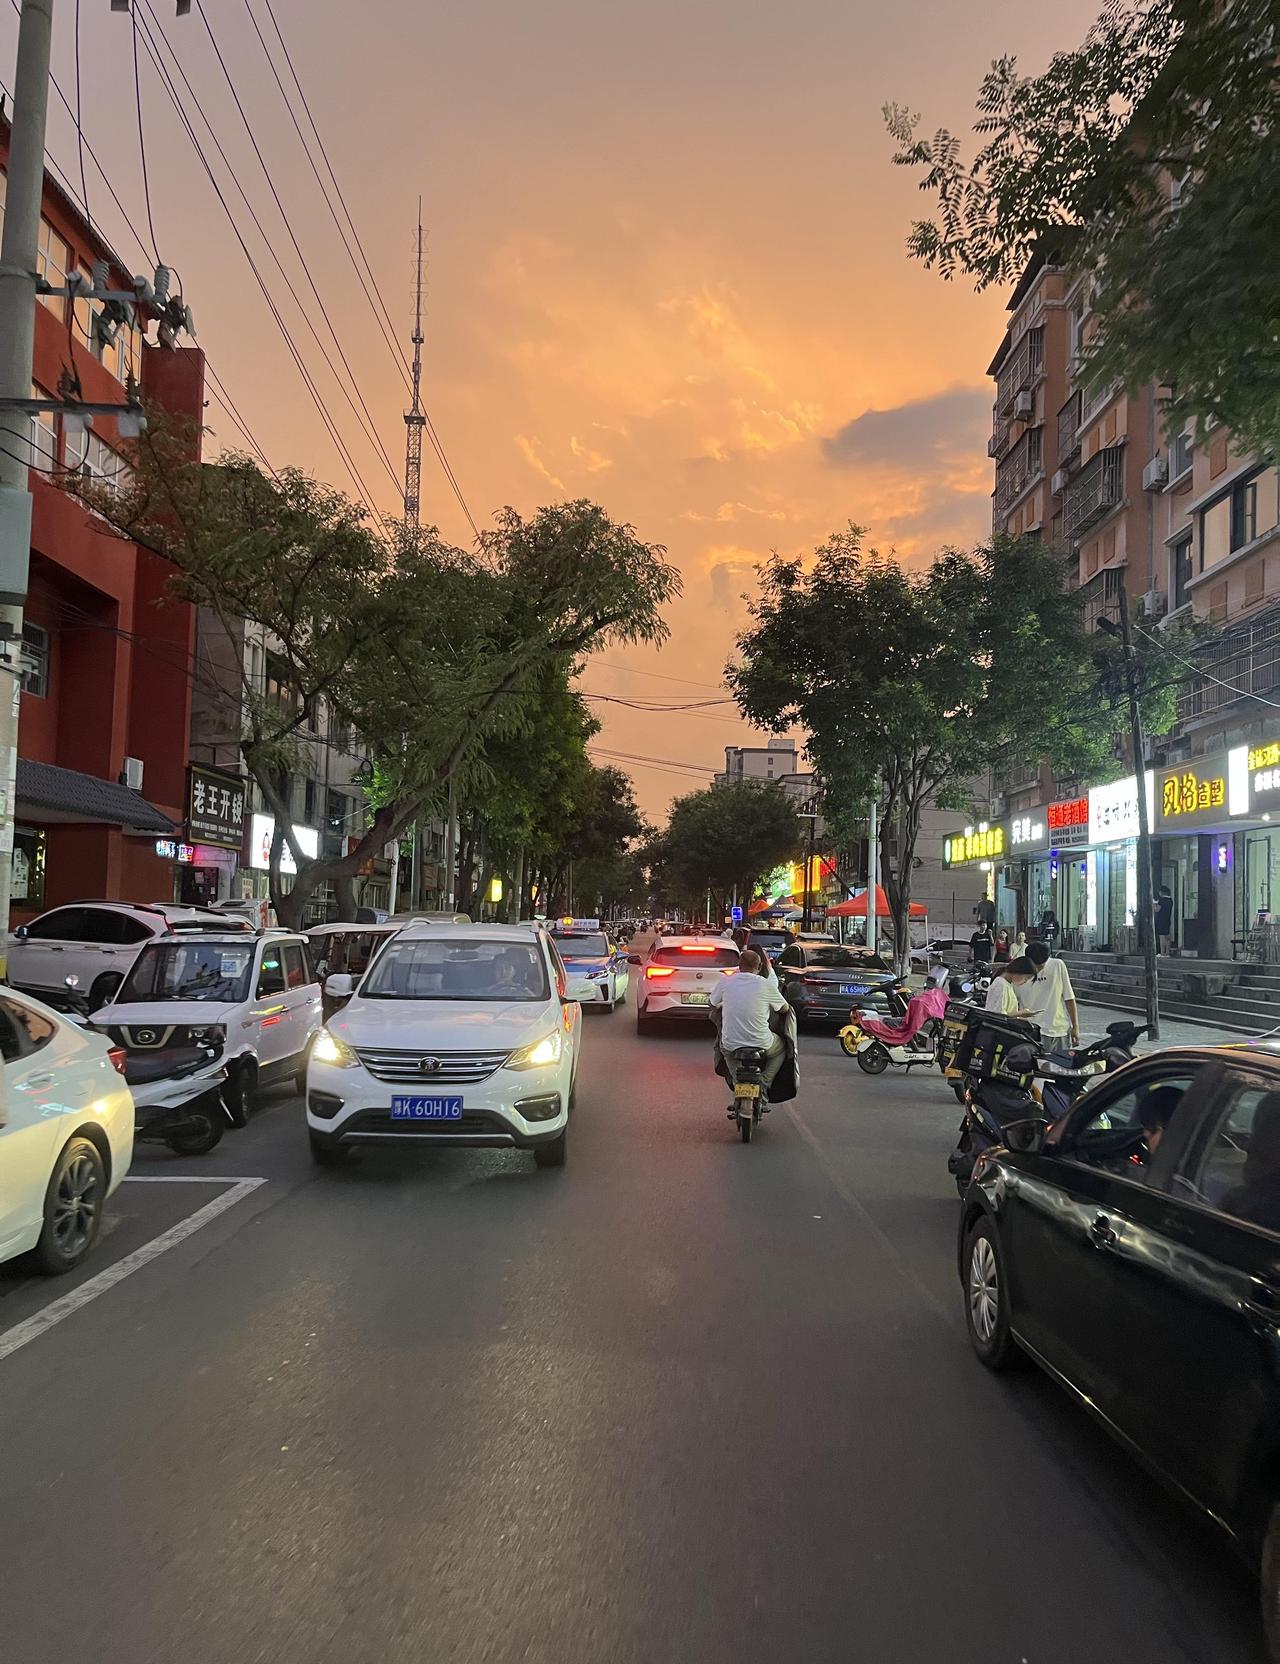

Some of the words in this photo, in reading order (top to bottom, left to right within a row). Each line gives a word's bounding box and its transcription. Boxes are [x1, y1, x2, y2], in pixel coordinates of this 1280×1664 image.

[193, 779, 244, 825] 老王开锁
[1163, 772, 1223, 816] 风格造型
